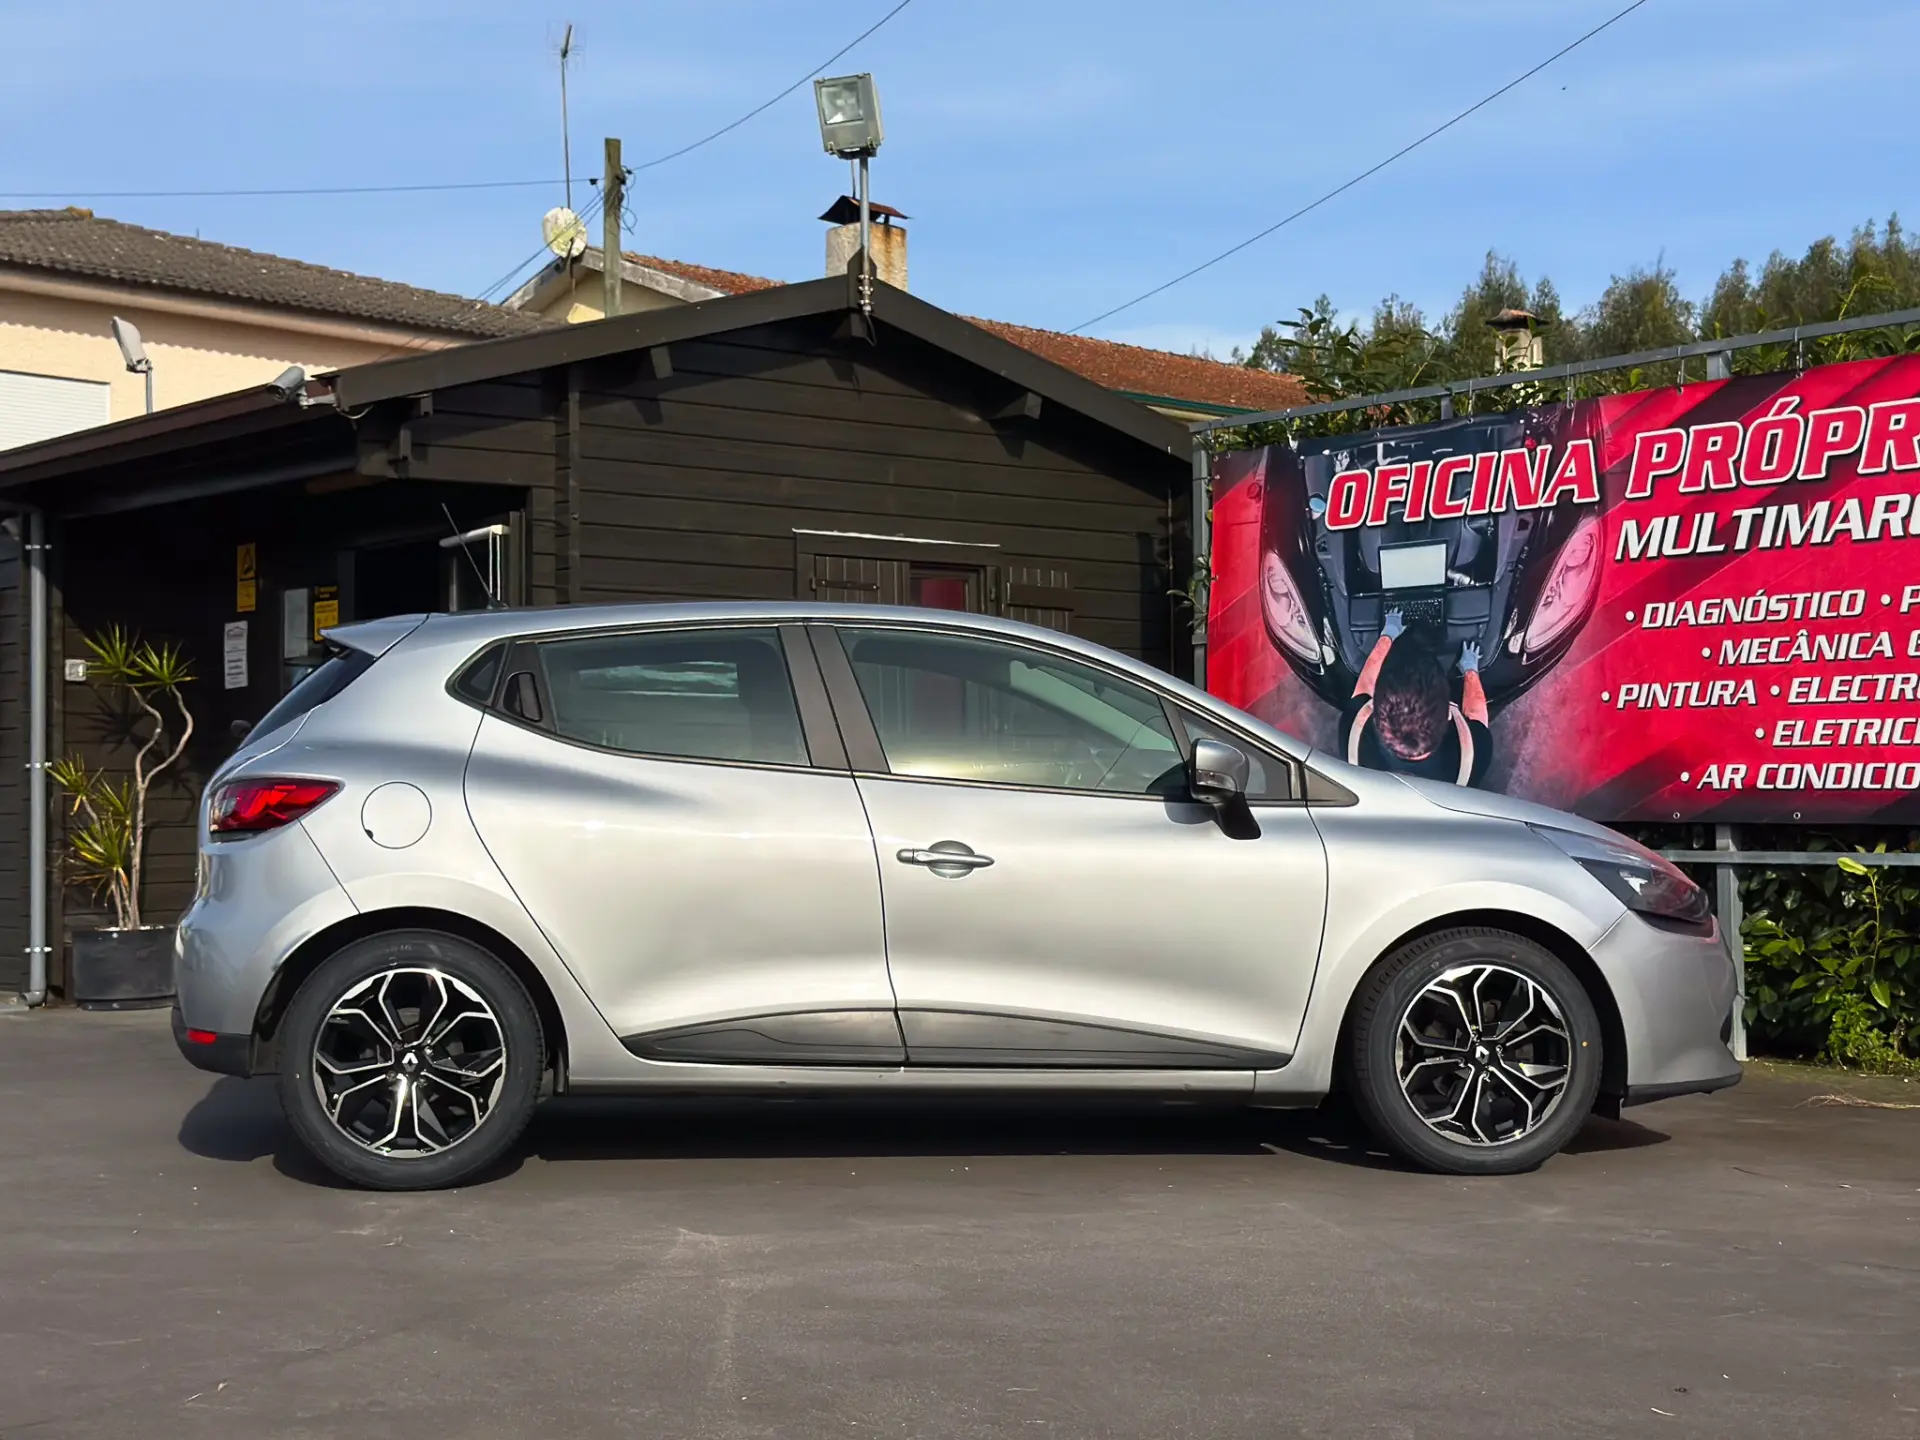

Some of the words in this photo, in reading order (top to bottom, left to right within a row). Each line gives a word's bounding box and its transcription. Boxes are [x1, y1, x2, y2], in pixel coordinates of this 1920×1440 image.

[1325, 438, 1600, 531] OFICINA
[1625, 395, 1920, 498] PRÓPR
[1641, 589, 1866, 628] DIAGNÓSTICO
[1717, 629, 1894, 665] MECÂNICA
[1616, 679, 1757, 708] PINTURA
[1787, 672, 1920, 704] ELECTR
[1696, 763, 1748, 790] AR
[1756, 762, 1920, 790] CONDICIO
